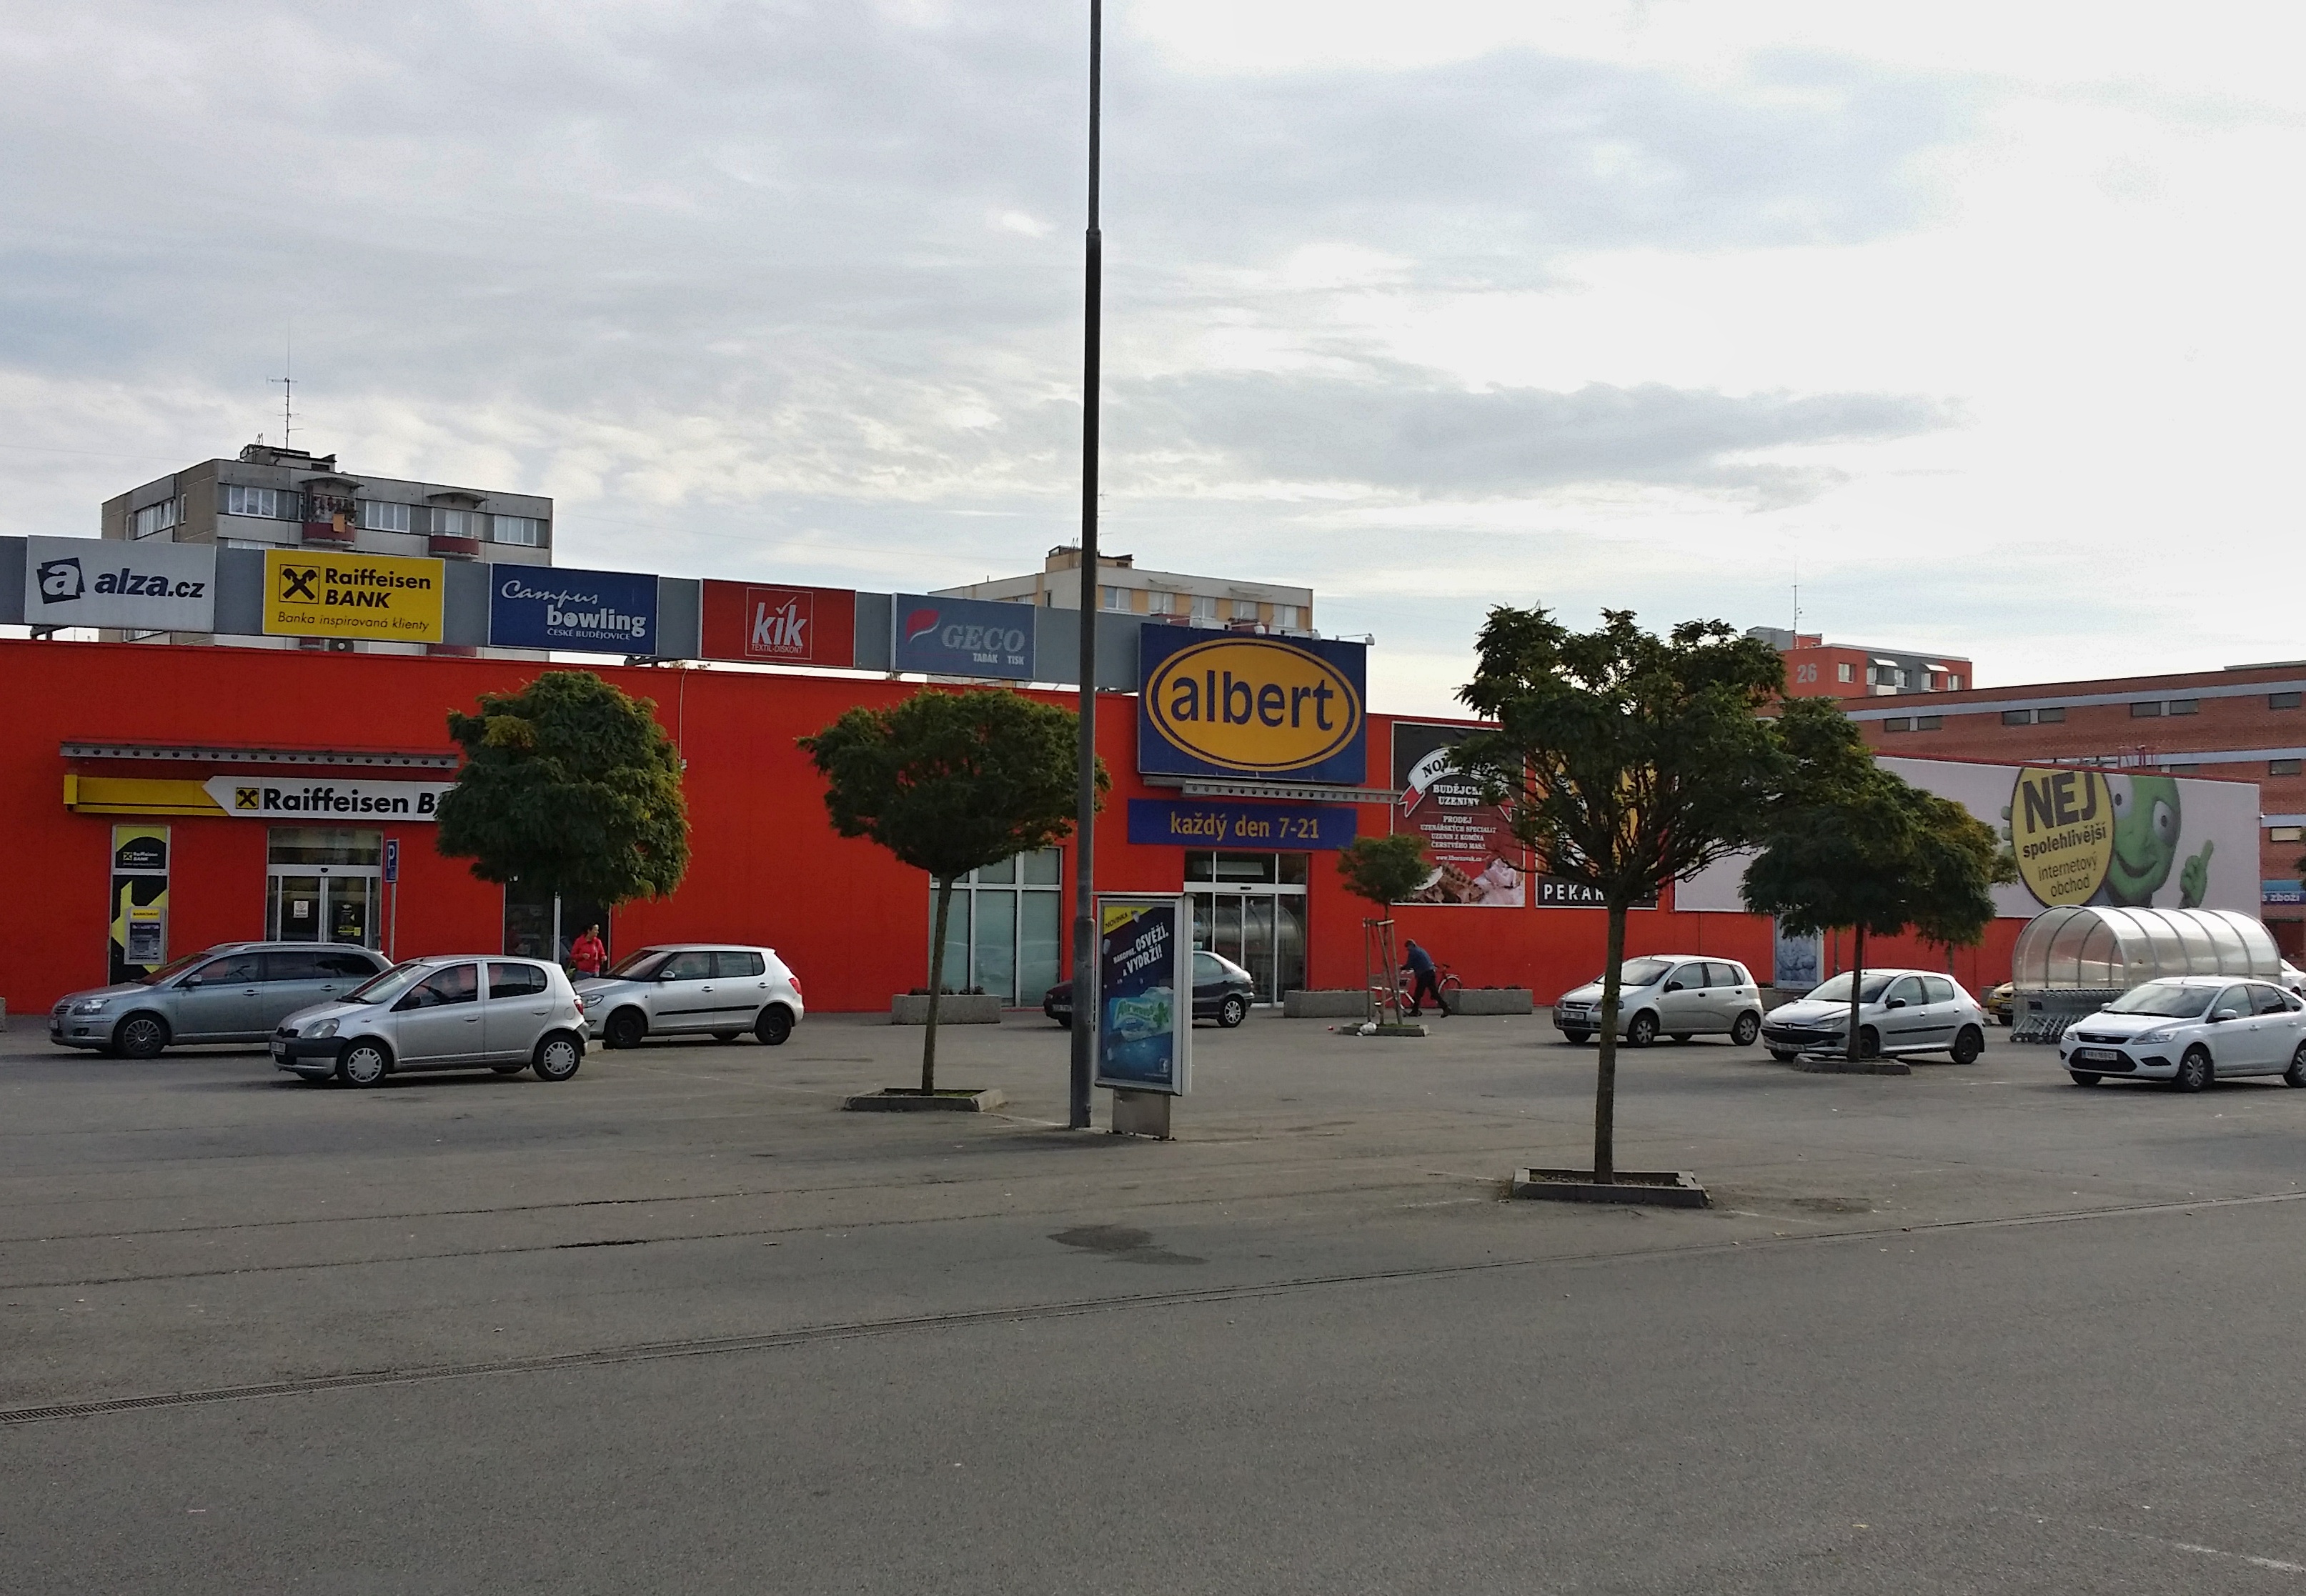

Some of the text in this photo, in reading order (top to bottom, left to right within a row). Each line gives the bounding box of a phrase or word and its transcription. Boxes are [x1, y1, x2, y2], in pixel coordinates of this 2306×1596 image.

[94, 568, 205, 598] alza.cz
[325, 568, 431, 589] Raiffeisen
[325, 589, 392, 609] BANK
[502, 580, 599, 609] Campus
[278, 612, 429, 632] Banka inspirovaná klienty
[547, 604, 647, 637] bowling
[547, 627, 630, 640] ČESKÉ BUDĚJOVICE
[752, 597, 807, 647] kik
[752, 644, 803, 654] TEXTIL-DISKONT
[942, 625, 1025, 652] GECO
[1007, 655, 1025, 665] TISK
[1797, 664, 1817, 683] 26
[1171, 669, 1333, 732] albert
[264, 788, 409, 813] Raiffeisen
[1437, 796, 1480, 806] UZENINY
[2022, 772, 2097, 834] NEJ
[1171, 812, 1319, 842] každý den 7-21
[1443, 815, 1473, 824] PRODEJ
[2022, 822, 2107, 860] spolehlivější
[387, 844, 396, 869] P
[2038, 851, 2098, 882] internetový
[2051, 873, 2090, 897] obchod
[1135, 922, 1169, 952] OSVĚŽÍ.
[1126, 943, 1163, 974] VYDRŽÍ!
